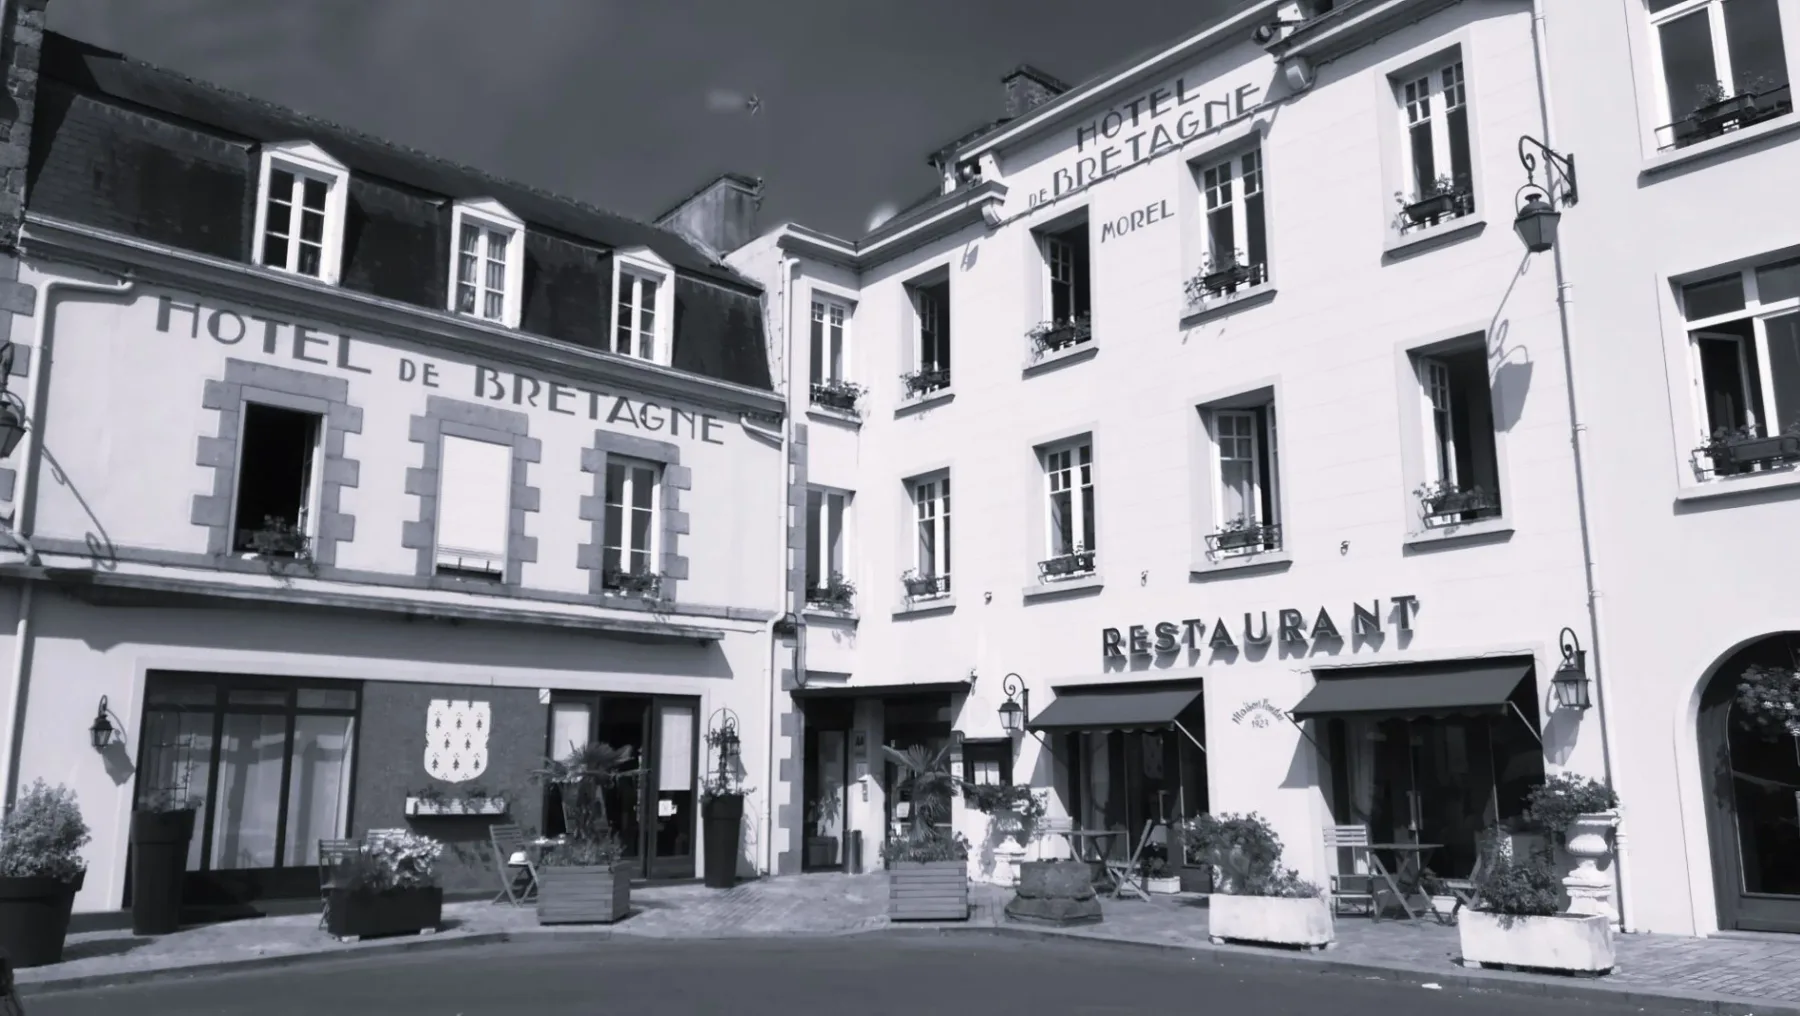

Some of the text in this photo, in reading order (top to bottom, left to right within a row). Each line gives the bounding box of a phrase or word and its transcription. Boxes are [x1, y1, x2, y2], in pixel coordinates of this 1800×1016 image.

[1029, 82, 1261, 207] DE BRETAGNE
[1101, 199, 1175, 243] MOREL
[156, 295, 724, 445] HOTEL DE BRETAGNE
[1103, 595, 1416, 656] RESTAURANT
